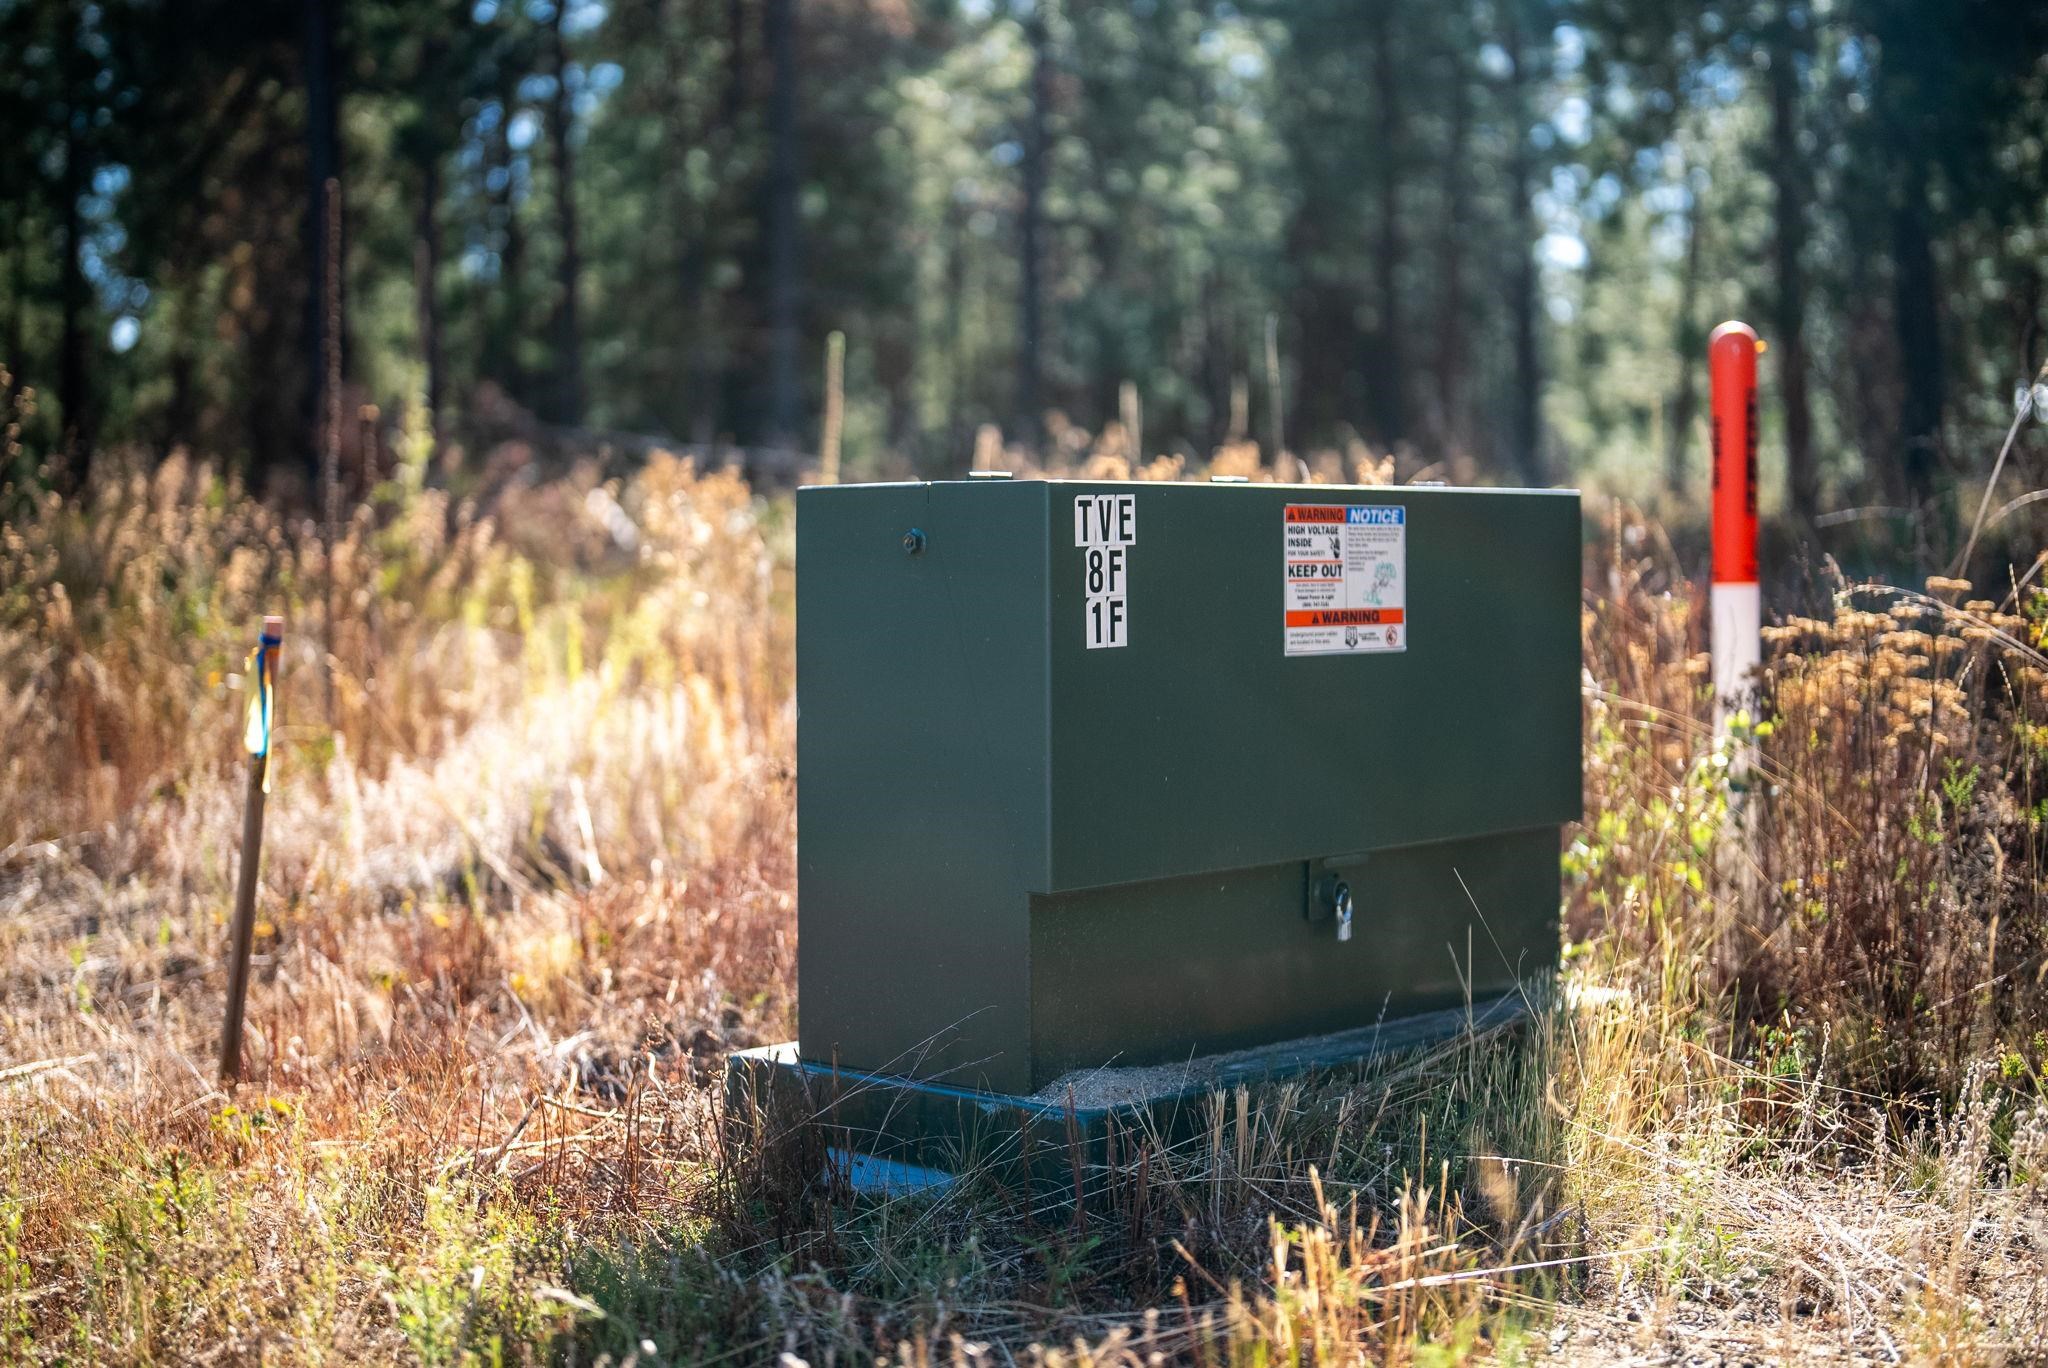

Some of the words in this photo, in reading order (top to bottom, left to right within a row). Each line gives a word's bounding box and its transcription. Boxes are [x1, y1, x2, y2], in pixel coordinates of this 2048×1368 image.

[1077, 499, 1133, 542] TVE
[1297, 508, 1344, 521] WARNING
[1350, 508, 1400, 523] NOTICE
[1288, 525, 1306, 535] HIGH
[1308, 525, 1339, 535] VOLTAGE
[1288, 537, 1312, 547] INSIDE
[1089, 550, 1123, 593] 8F
[1288, 563, 1318, 578] KEEP
[1321, 563, 1343, 578] OUT
[1092, 600, 1124, 644] 1F
[1321, 609, 1380, 624] WARNING
